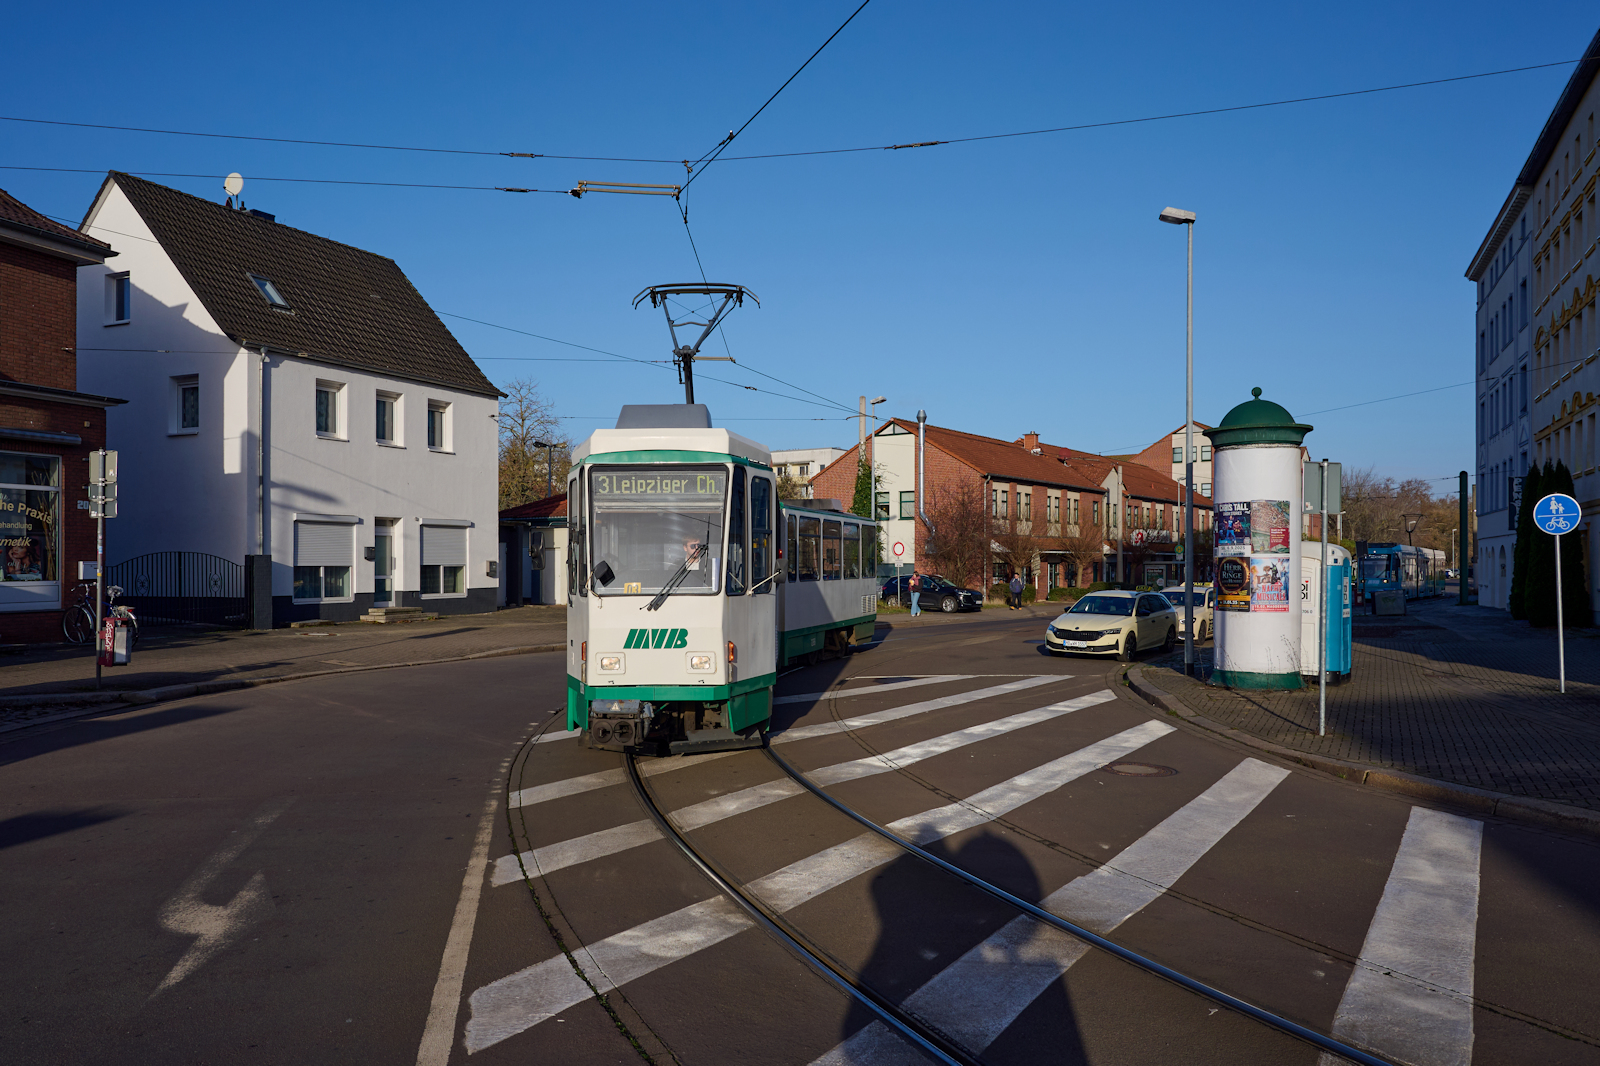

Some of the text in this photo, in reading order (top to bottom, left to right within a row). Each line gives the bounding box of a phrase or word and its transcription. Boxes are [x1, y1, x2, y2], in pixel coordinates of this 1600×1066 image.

[598, 475, 720, 494] 3 Leipziger Ch.
[17, 502, 53, 524] Praxis
[1233, 502, 1249, 511] TALL
